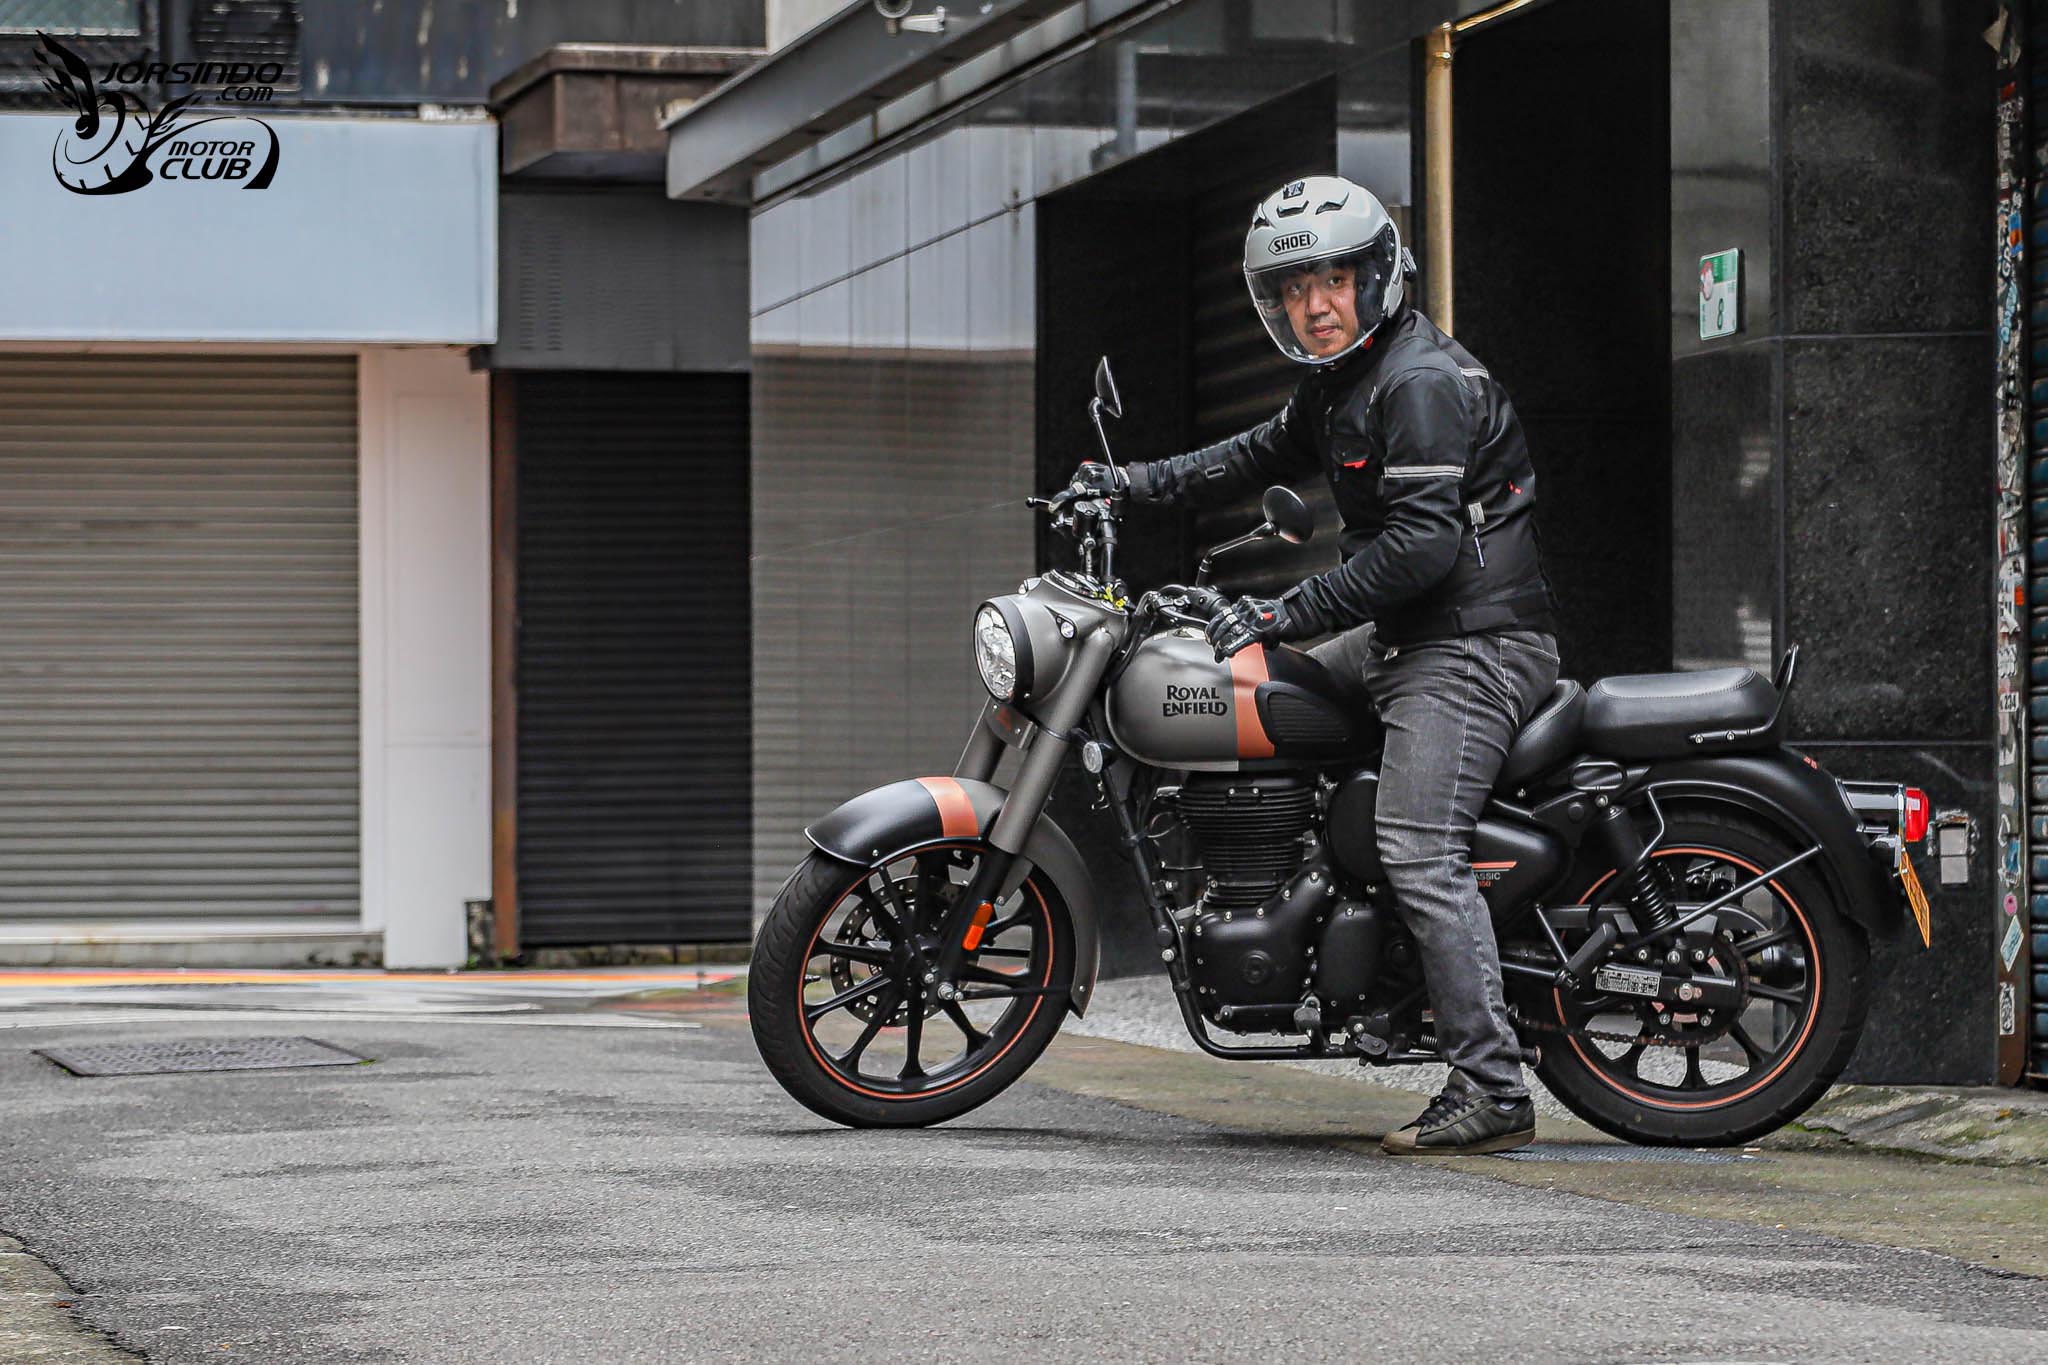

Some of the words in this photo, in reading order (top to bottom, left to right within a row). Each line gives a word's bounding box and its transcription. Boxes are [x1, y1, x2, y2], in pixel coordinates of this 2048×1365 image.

[1274, 234, 1311, 252] SHOEI
[1167, 685, 1220, 700] ROYAL
[1162, 701, 1228, 717] ENFIELD
